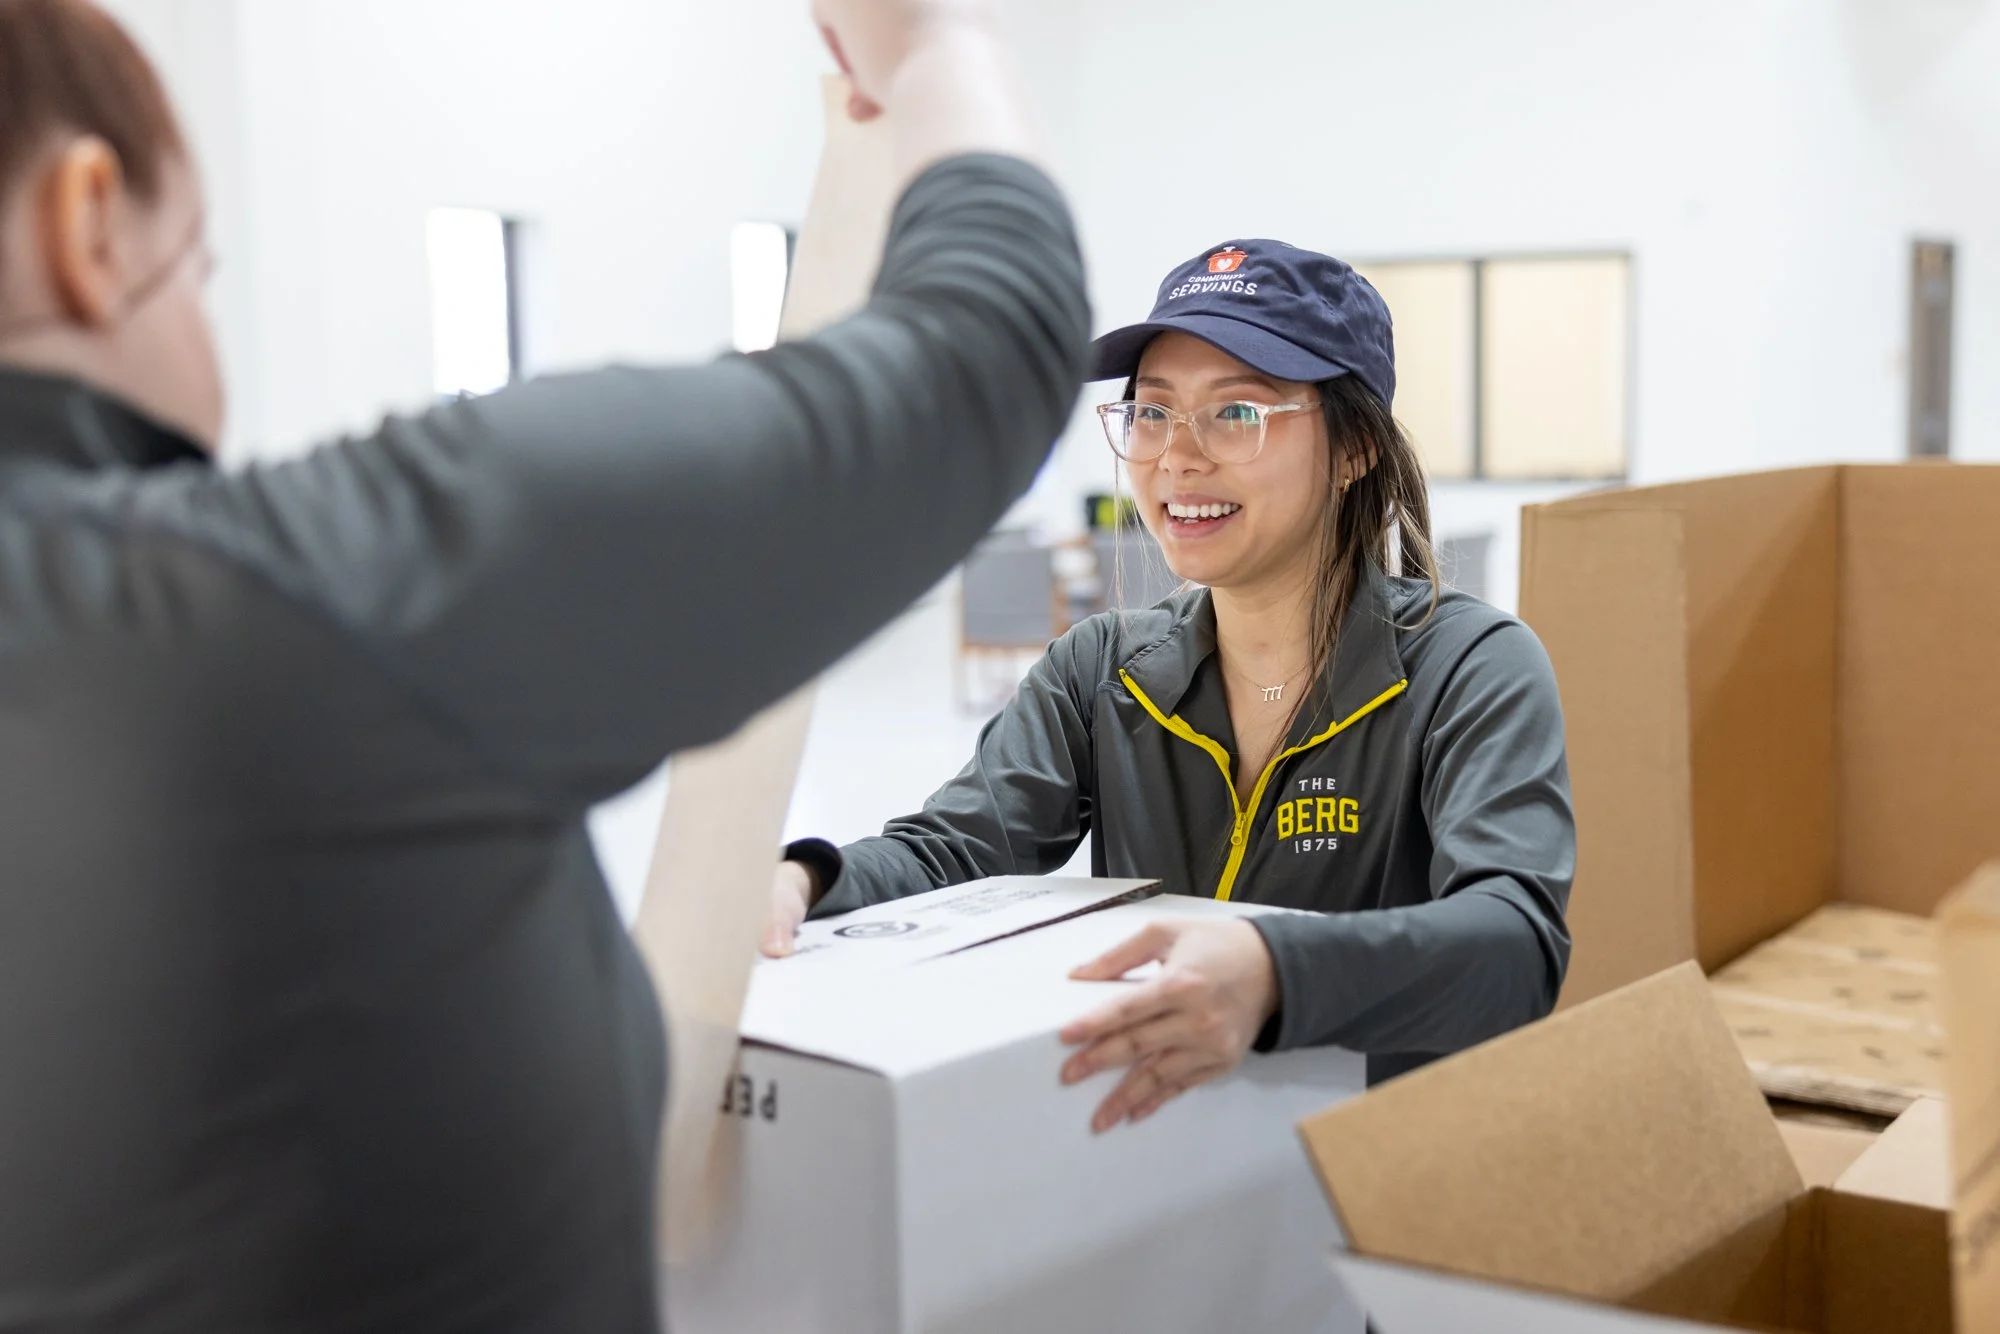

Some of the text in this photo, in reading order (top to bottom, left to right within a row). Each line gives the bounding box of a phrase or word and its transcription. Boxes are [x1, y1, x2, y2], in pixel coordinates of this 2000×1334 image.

[1188, 273, 1246, 283] COMMUNITY
[1168, 280, 1258, 300] SERVINGS
[1298, 777, 1336, 792] THE
[1277, 797, 1359, 841] BERG
[1294, 838, 1338, 854] 1975
